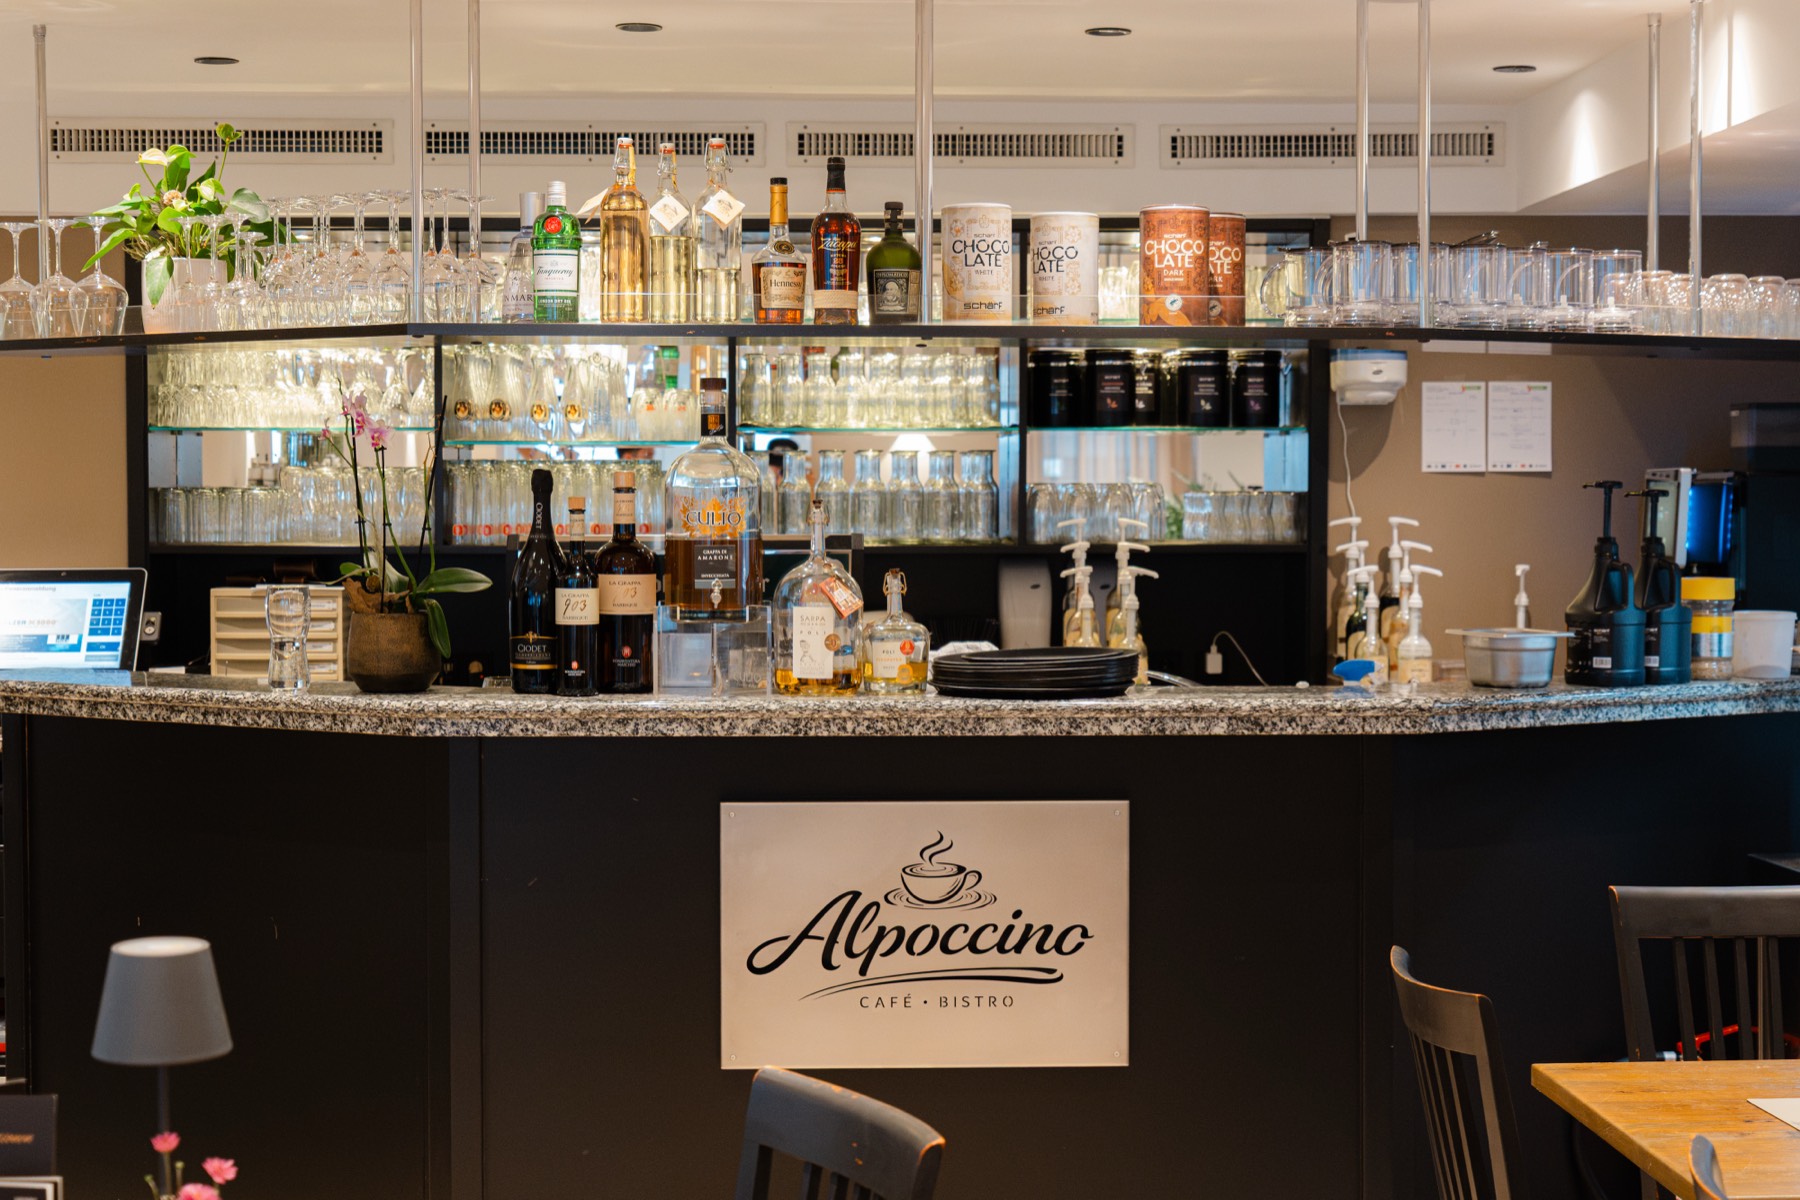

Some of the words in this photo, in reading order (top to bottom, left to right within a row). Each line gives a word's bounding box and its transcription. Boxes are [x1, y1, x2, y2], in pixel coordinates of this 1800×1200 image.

[952, 239, 1010, 255] CHOCO
[1032, 246, 1079, 261] HOCO
[1144, 239, 1204, 255] CHOCO
[1209, 246, 1242, 261] OCO
[964, 253, 1003, 267] LATE
[1155, 253, 1194, 268] LATE
[511, 294, 533, 302] MAR
[563, 598, 587, 616] 903
[746, 889, 1094, 977] Alpoccino
[859, 993, 912, 1009] CAFÉ
[939, 995, 1015, 1009] BISTRO
